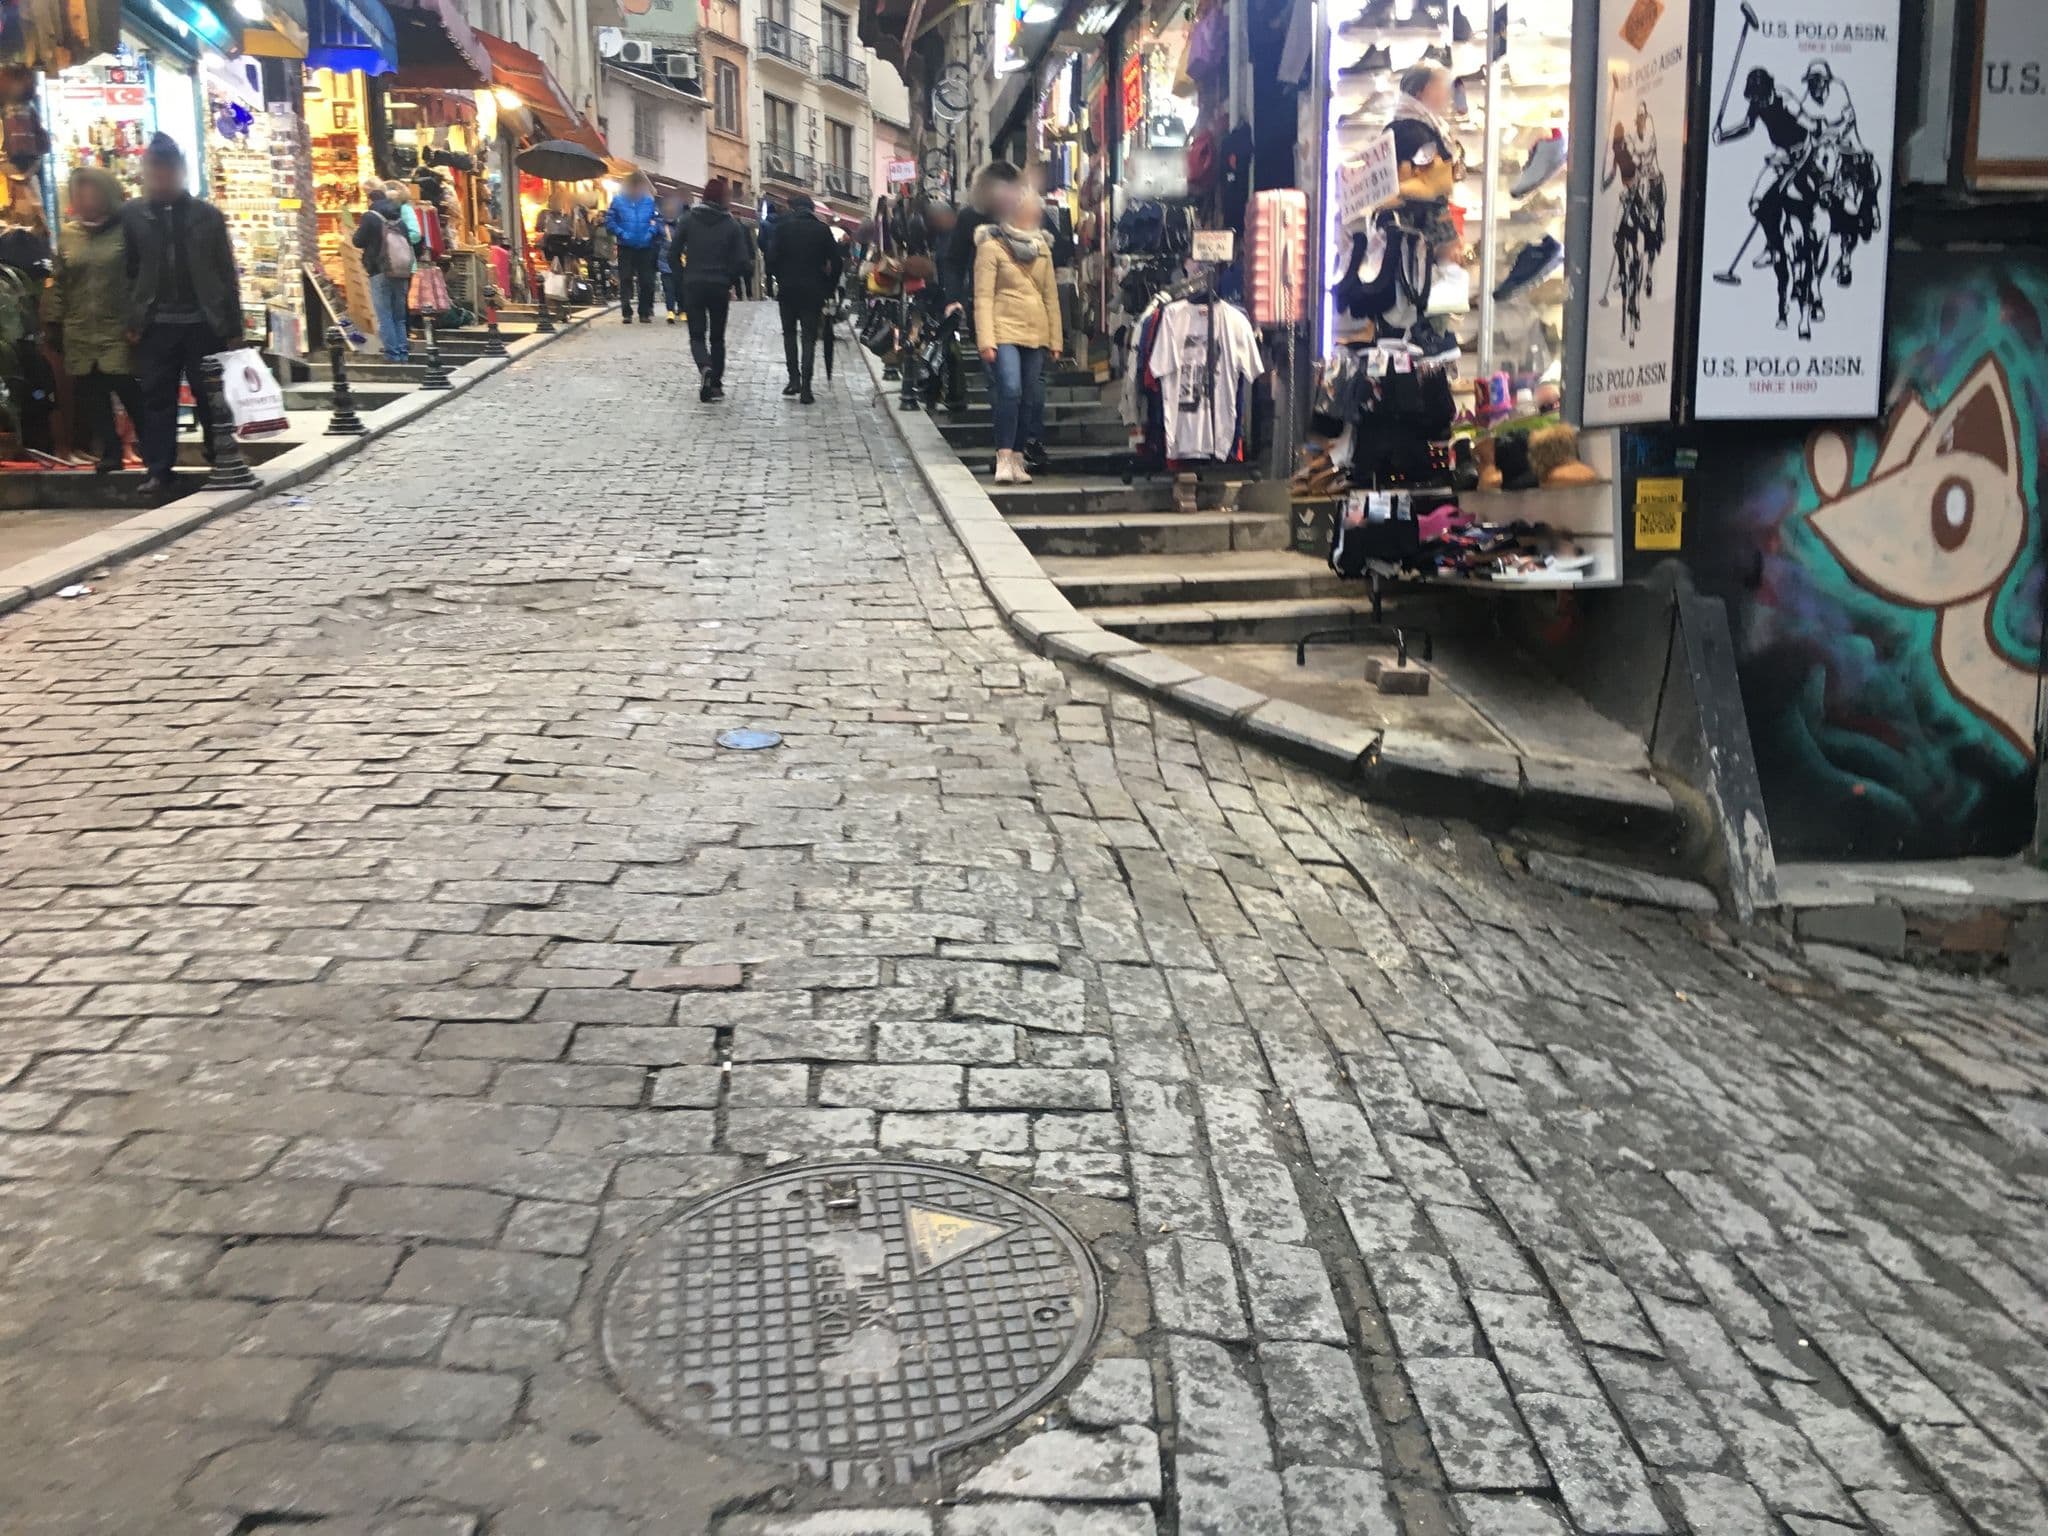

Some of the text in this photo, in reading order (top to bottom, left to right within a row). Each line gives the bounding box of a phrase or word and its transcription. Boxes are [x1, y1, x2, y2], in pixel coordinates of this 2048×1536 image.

[1795, 21, 1838, 40] POLO
[1843, 23, 1888, 41] ASSN.
[1986, 62, 2046, 94] U.S.
[1702, 355, 1864, 378] U.S. POLO ASSN.
[1606, 367, 1635, 391] POLO
[1750, 380, 1785, 393] SINCE
[815, 1249, 852, 1356] ELEKOM
